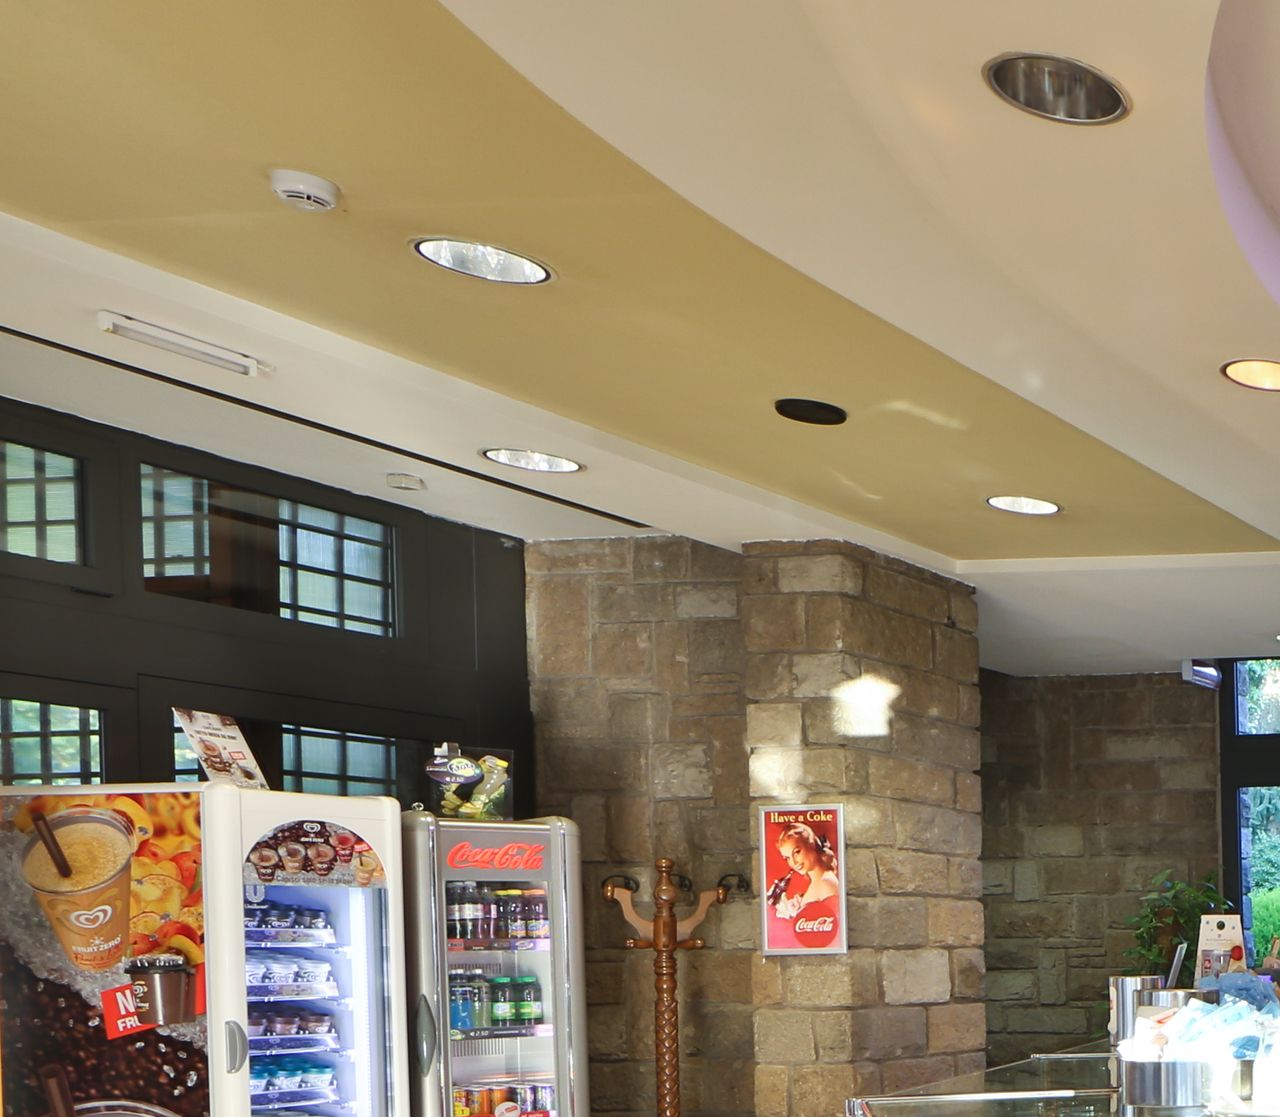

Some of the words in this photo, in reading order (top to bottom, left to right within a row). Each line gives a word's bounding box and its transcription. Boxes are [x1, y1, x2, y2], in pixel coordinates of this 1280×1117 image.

[770, 812, 796, 823] Have
[806, 811, 833, 822] Coke
[447, 841, 545, 871] Coca-Cola
[795, 916, 834, 933] Coca-Cola
[98, 936, 122, 952] ZERO
